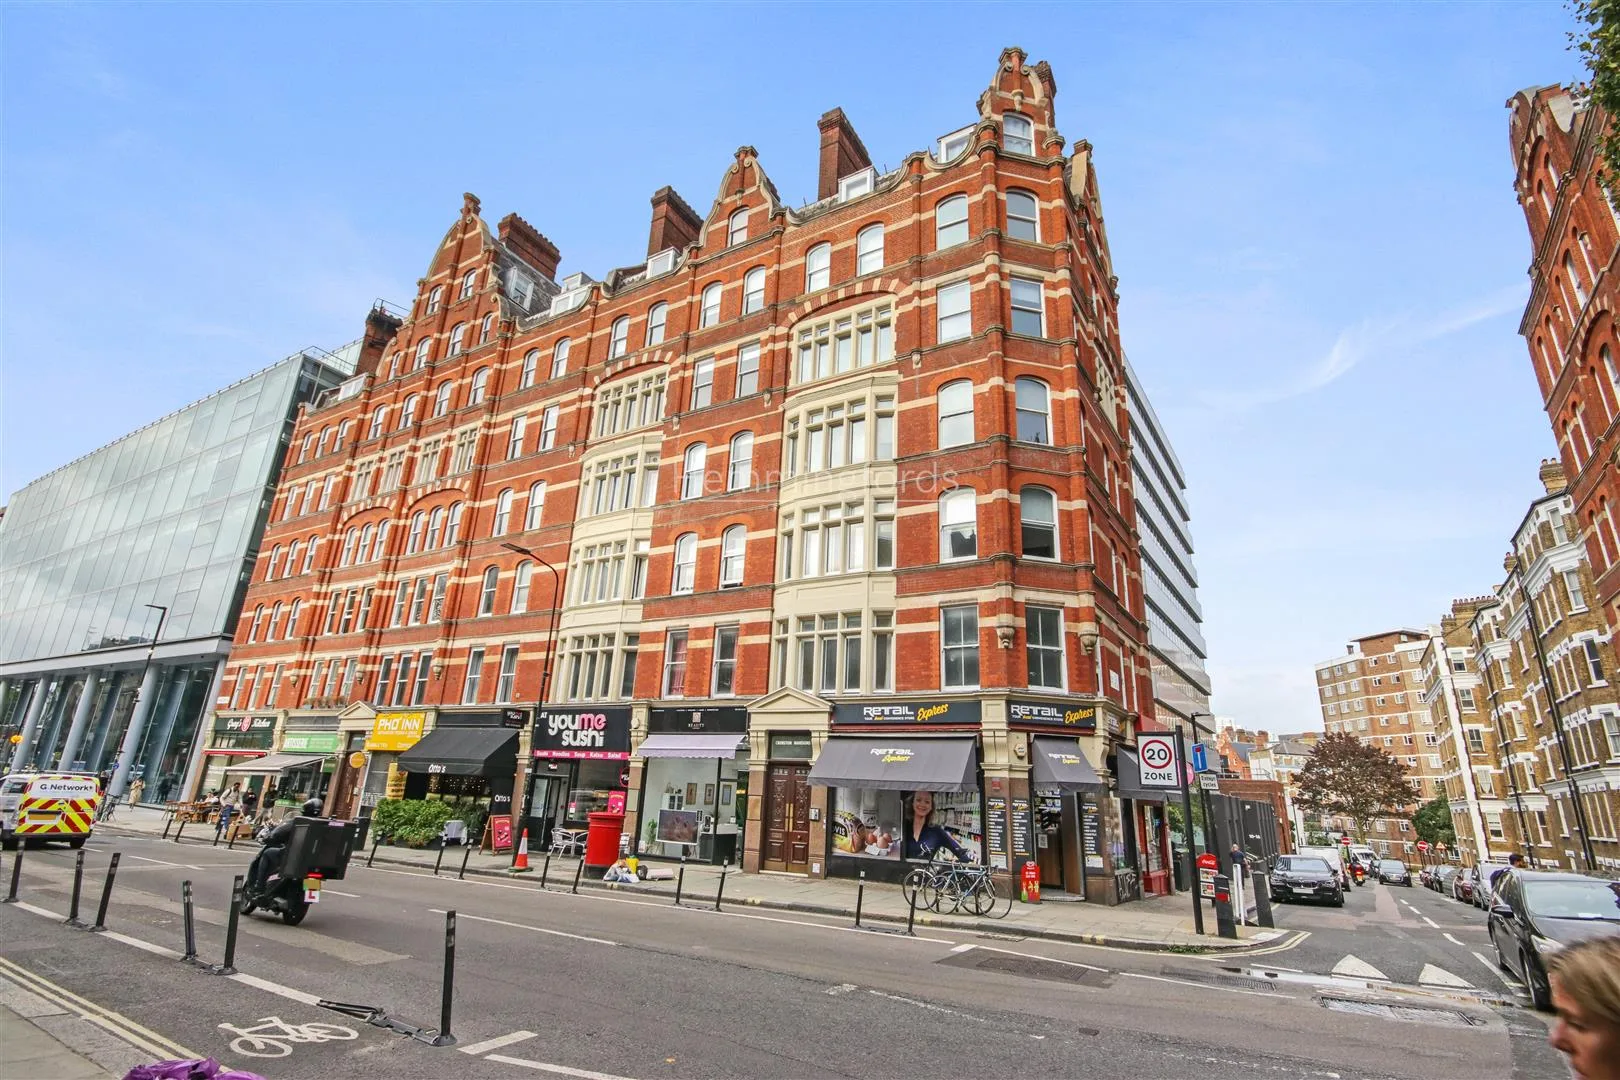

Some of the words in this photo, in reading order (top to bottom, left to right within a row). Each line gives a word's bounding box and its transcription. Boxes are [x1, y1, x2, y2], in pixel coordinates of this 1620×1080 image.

[916, 703, 949, 721] Express
[1064, 707, 1094, 724] Express
[401, 718, 420, 731] INN
[562, 728, 605, 747] sushi
[574, 751, 586, 759] Soup
[1146, 748, 1168, 761] 20
[428, 763, 447, 774] Otto's
[1144, 772, 1173, 781] ZONE
[494, 794, 511, 803] Otto's
[308, 890, 316, 900] L
